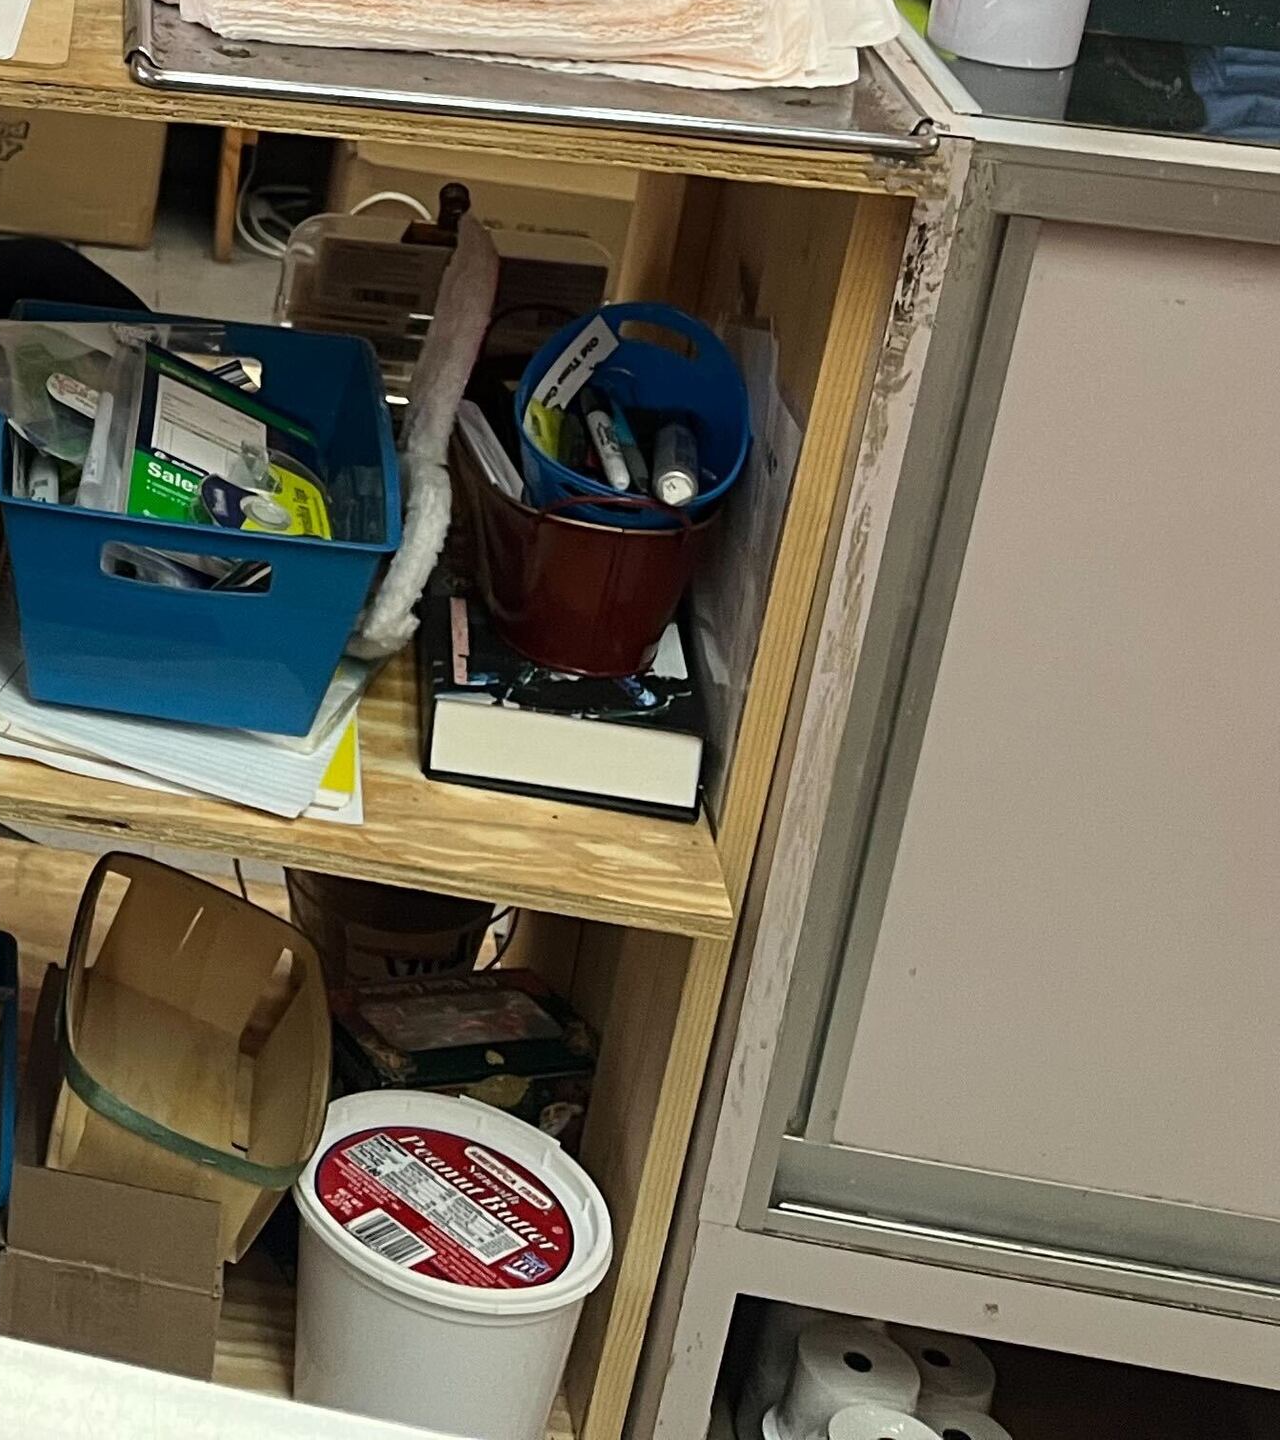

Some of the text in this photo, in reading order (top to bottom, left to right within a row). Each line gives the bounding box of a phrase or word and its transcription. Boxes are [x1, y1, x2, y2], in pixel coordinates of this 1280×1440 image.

[397, 1134, 560, 1252] Peanut Butter
[464, 1164, 521, 1206] Smooth
